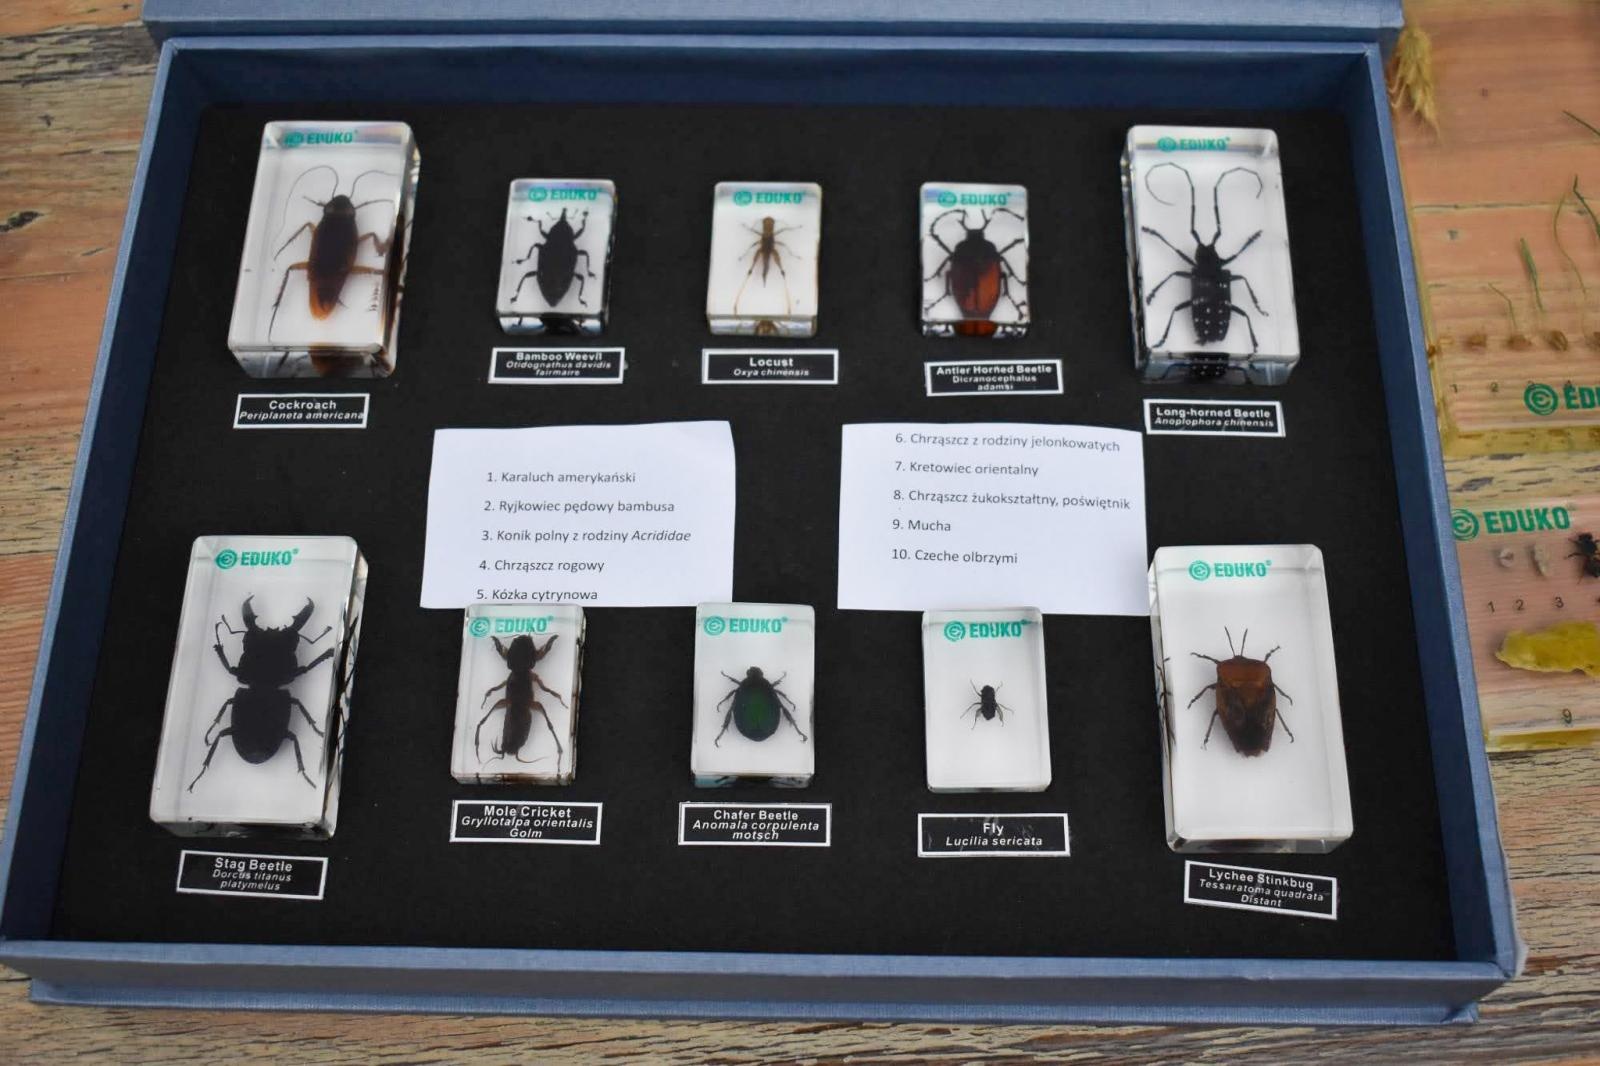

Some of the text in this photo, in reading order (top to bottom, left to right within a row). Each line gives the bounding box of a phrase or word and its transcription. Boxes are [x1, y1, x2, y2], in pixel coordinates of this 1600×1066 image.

[516, 352, 603, 361] Bamboo Weevil
[749, 357, 794, 367] Locust
[575, 361, 611, 369] davidis
[936, 364, 1052, 375] Antler Horned Beetle
[760, 368, 810, 376] chinensis
[269, 399, 337, 410] Cockroach
[239, 411, 365, 421] Periplaneta americana
[1156, 407, 1271, 418] Long-horned Beetle
[1154, 417, 1274, 428] Anoplophora chinensis
[895, 433, 1120, 452] 6. Chrząszcz z rodziny jelonkowatych
[895, 460, 1039, 477] 7. Kretowiec orientalny
[487, 471, 636, 484] 1. Karaluch amerykański
[893, 489, 1131, 511] 8. Chrząszcz żukokształtny, poświętnik
[483, 500, 675, 514] 2. Ryjkowiec pędowy bambusa
[892, 519, 951, 532] 9. Mucha
[1483, 506, 1571, 534] EDUKO
[481, 529, 692, 543] 3. Konik polny z rodziny Acrididae
[891, 548, 1018, 566] 10. Czeche olbrzymi
[479, 559, 605, 573] 4. Chrząszcz rogowy
[476, 588, 598, 602] 5. Kózka cytrynowa
[1487, 601, 1496, 612] 1
[1515, 599, 1524, 611] 2
[1554, 597, 1564, 608] 3
[1562, 708, 1572, 724] 9
[484, 805, 571, 818] Mole Cricket
[713, 809, 799, 821] Chafer Beetle
[461, 815, 593, 829] Gryllotalpa orientalis
[692, 819, 819, 832] Anomala corpulenta
[509, 828, 543, 838] Golm
[732, 830, 779, 840] motsch
[982, 822, 1004, 836] Fly
[945, 836, 1043, 846] Lucilia sericata
[214, 857, 293, 872] Stag Beetle
[212, 869, 292, 882] Dorcus titanus
[1208, 868, 1314, 892] Lychee Stinkbug
[220, 879, 281, 891] platymelus
[1199, 878, 1324, 902] Tessaratoma quadrata
[1240, 894, 1283, 908] Distant
